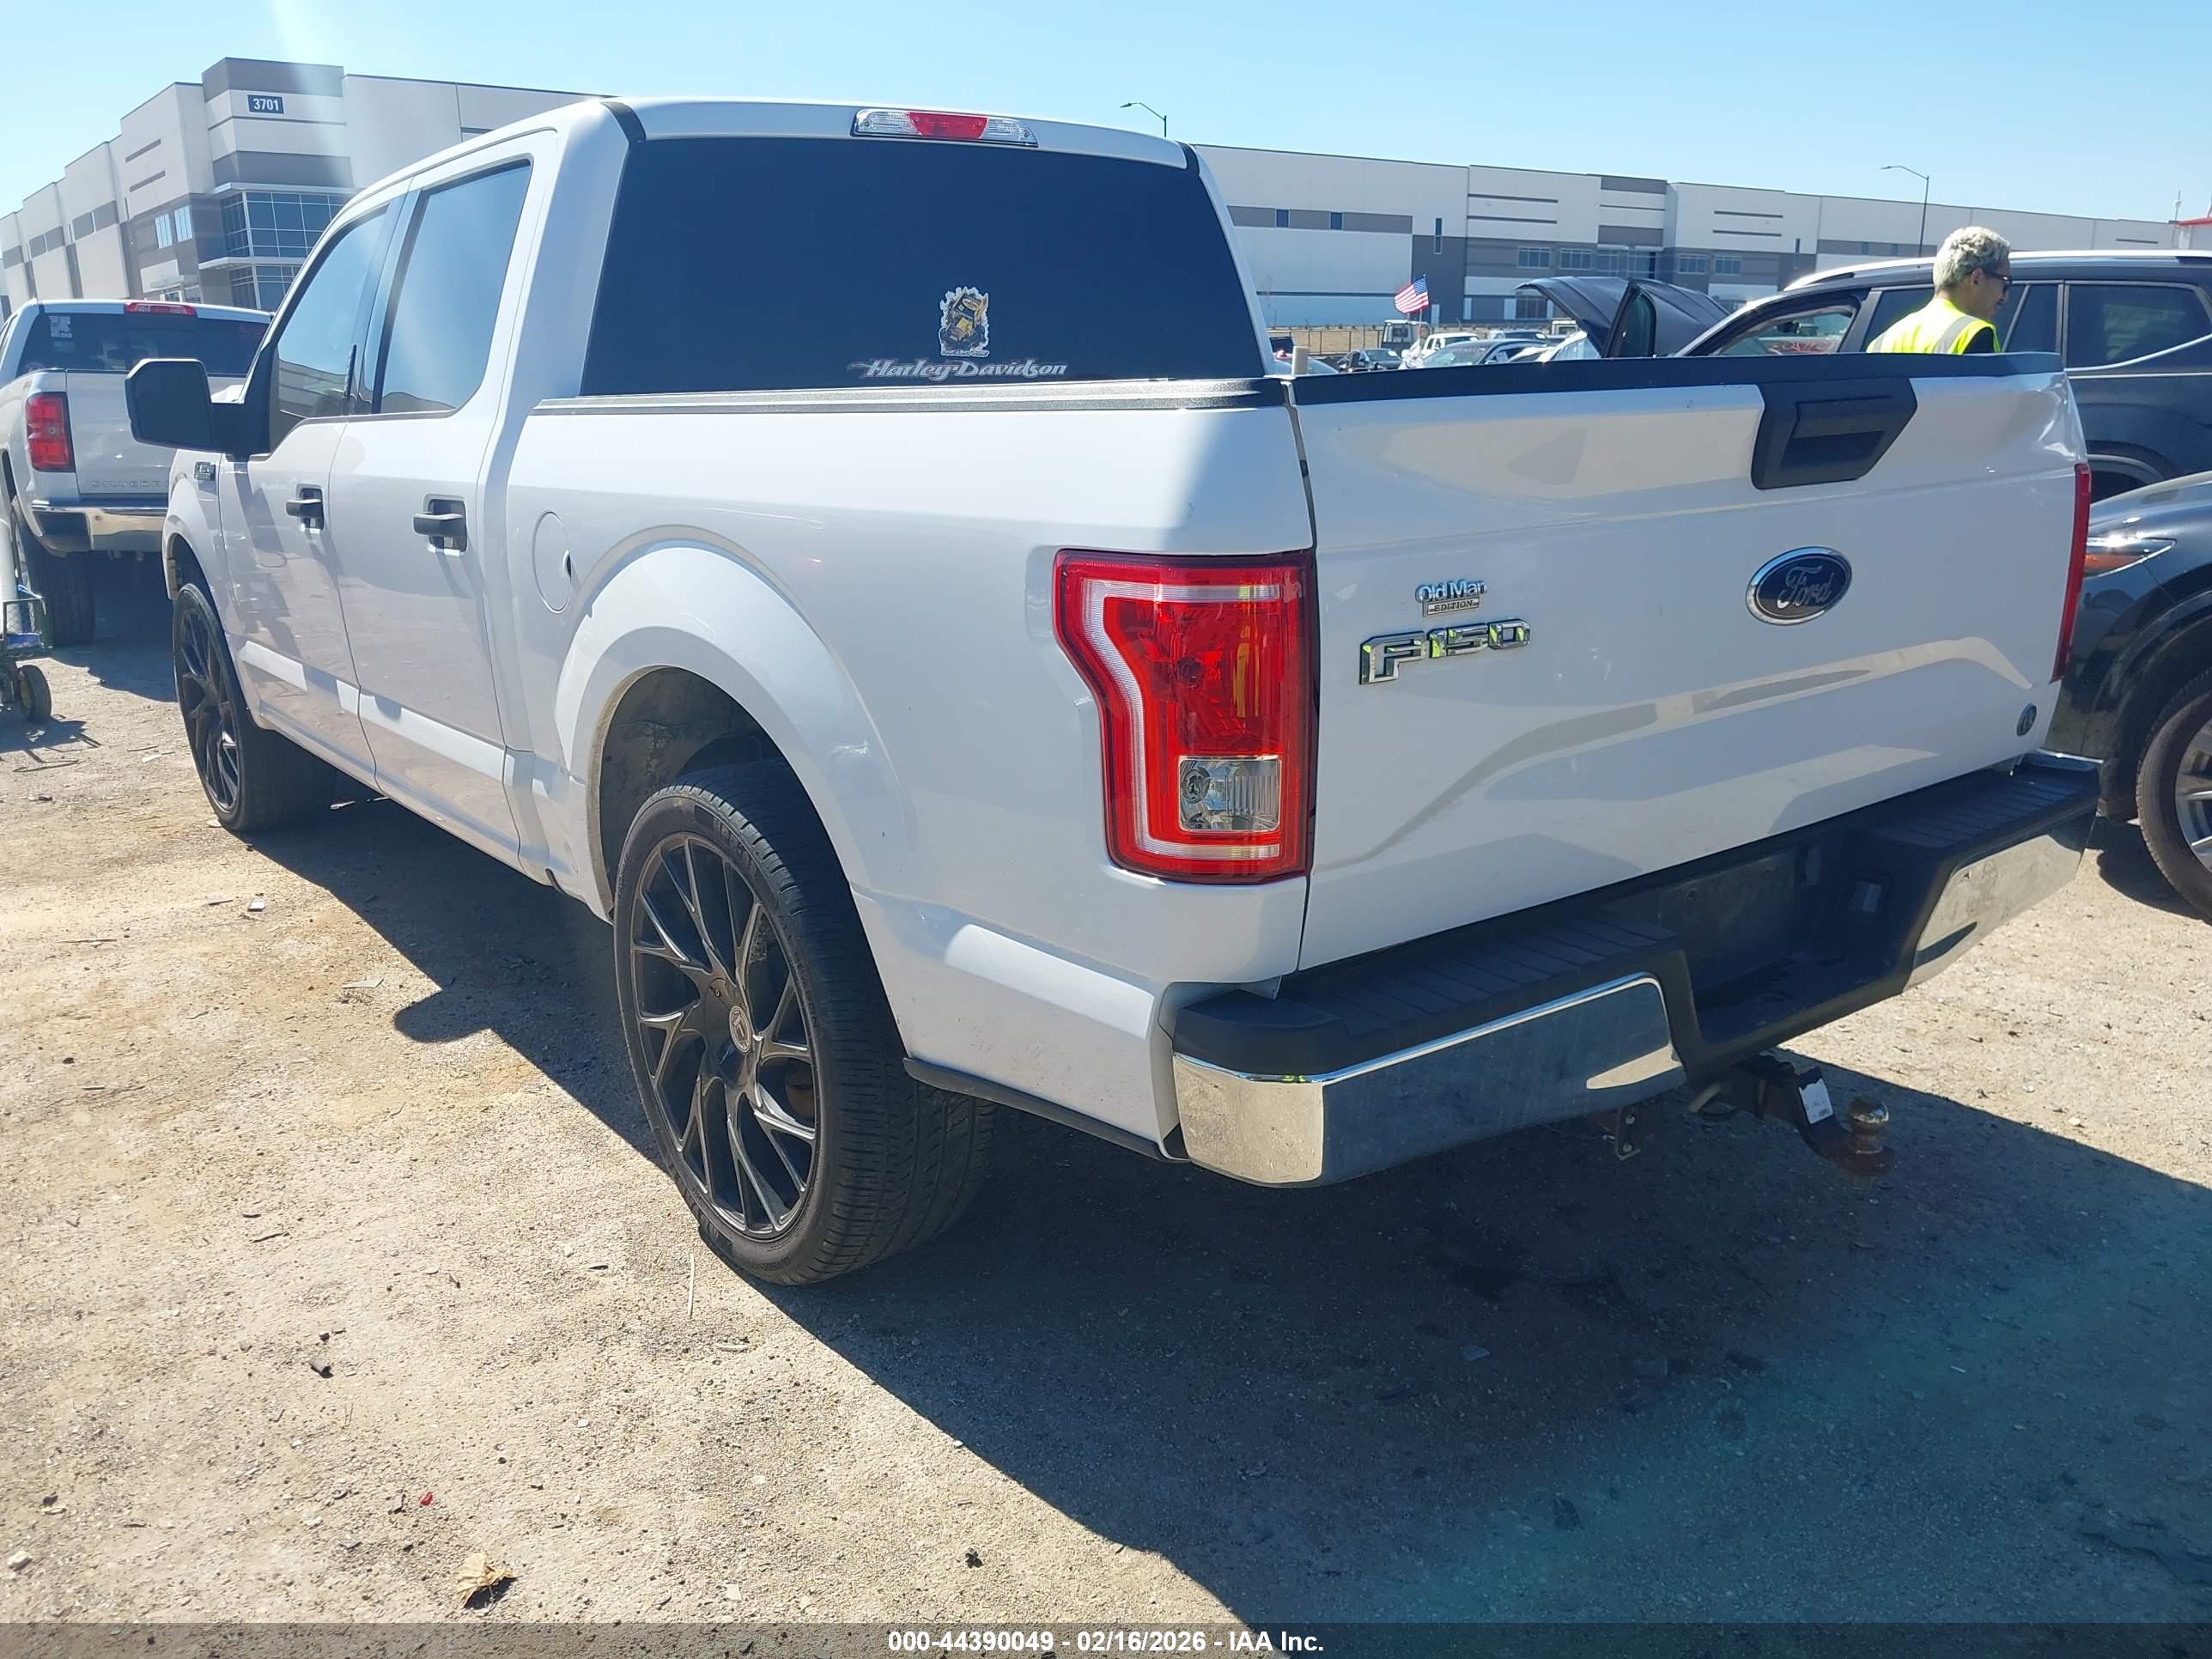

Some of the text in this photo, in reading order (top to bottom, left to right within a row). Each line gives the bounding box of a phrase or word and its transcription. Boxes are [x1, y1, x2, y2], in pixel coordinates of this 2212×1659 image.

[252, 98, 279, 111] 3701
[848, 357, 1067, 382] Harley-Davidson
[1415, 580, 1486, 603] Old Man
[1776, 565, 1836, 609] Ford
[1433, 599, 1474, 611] EDITION
[1359, 617, 1532, 685] F150
